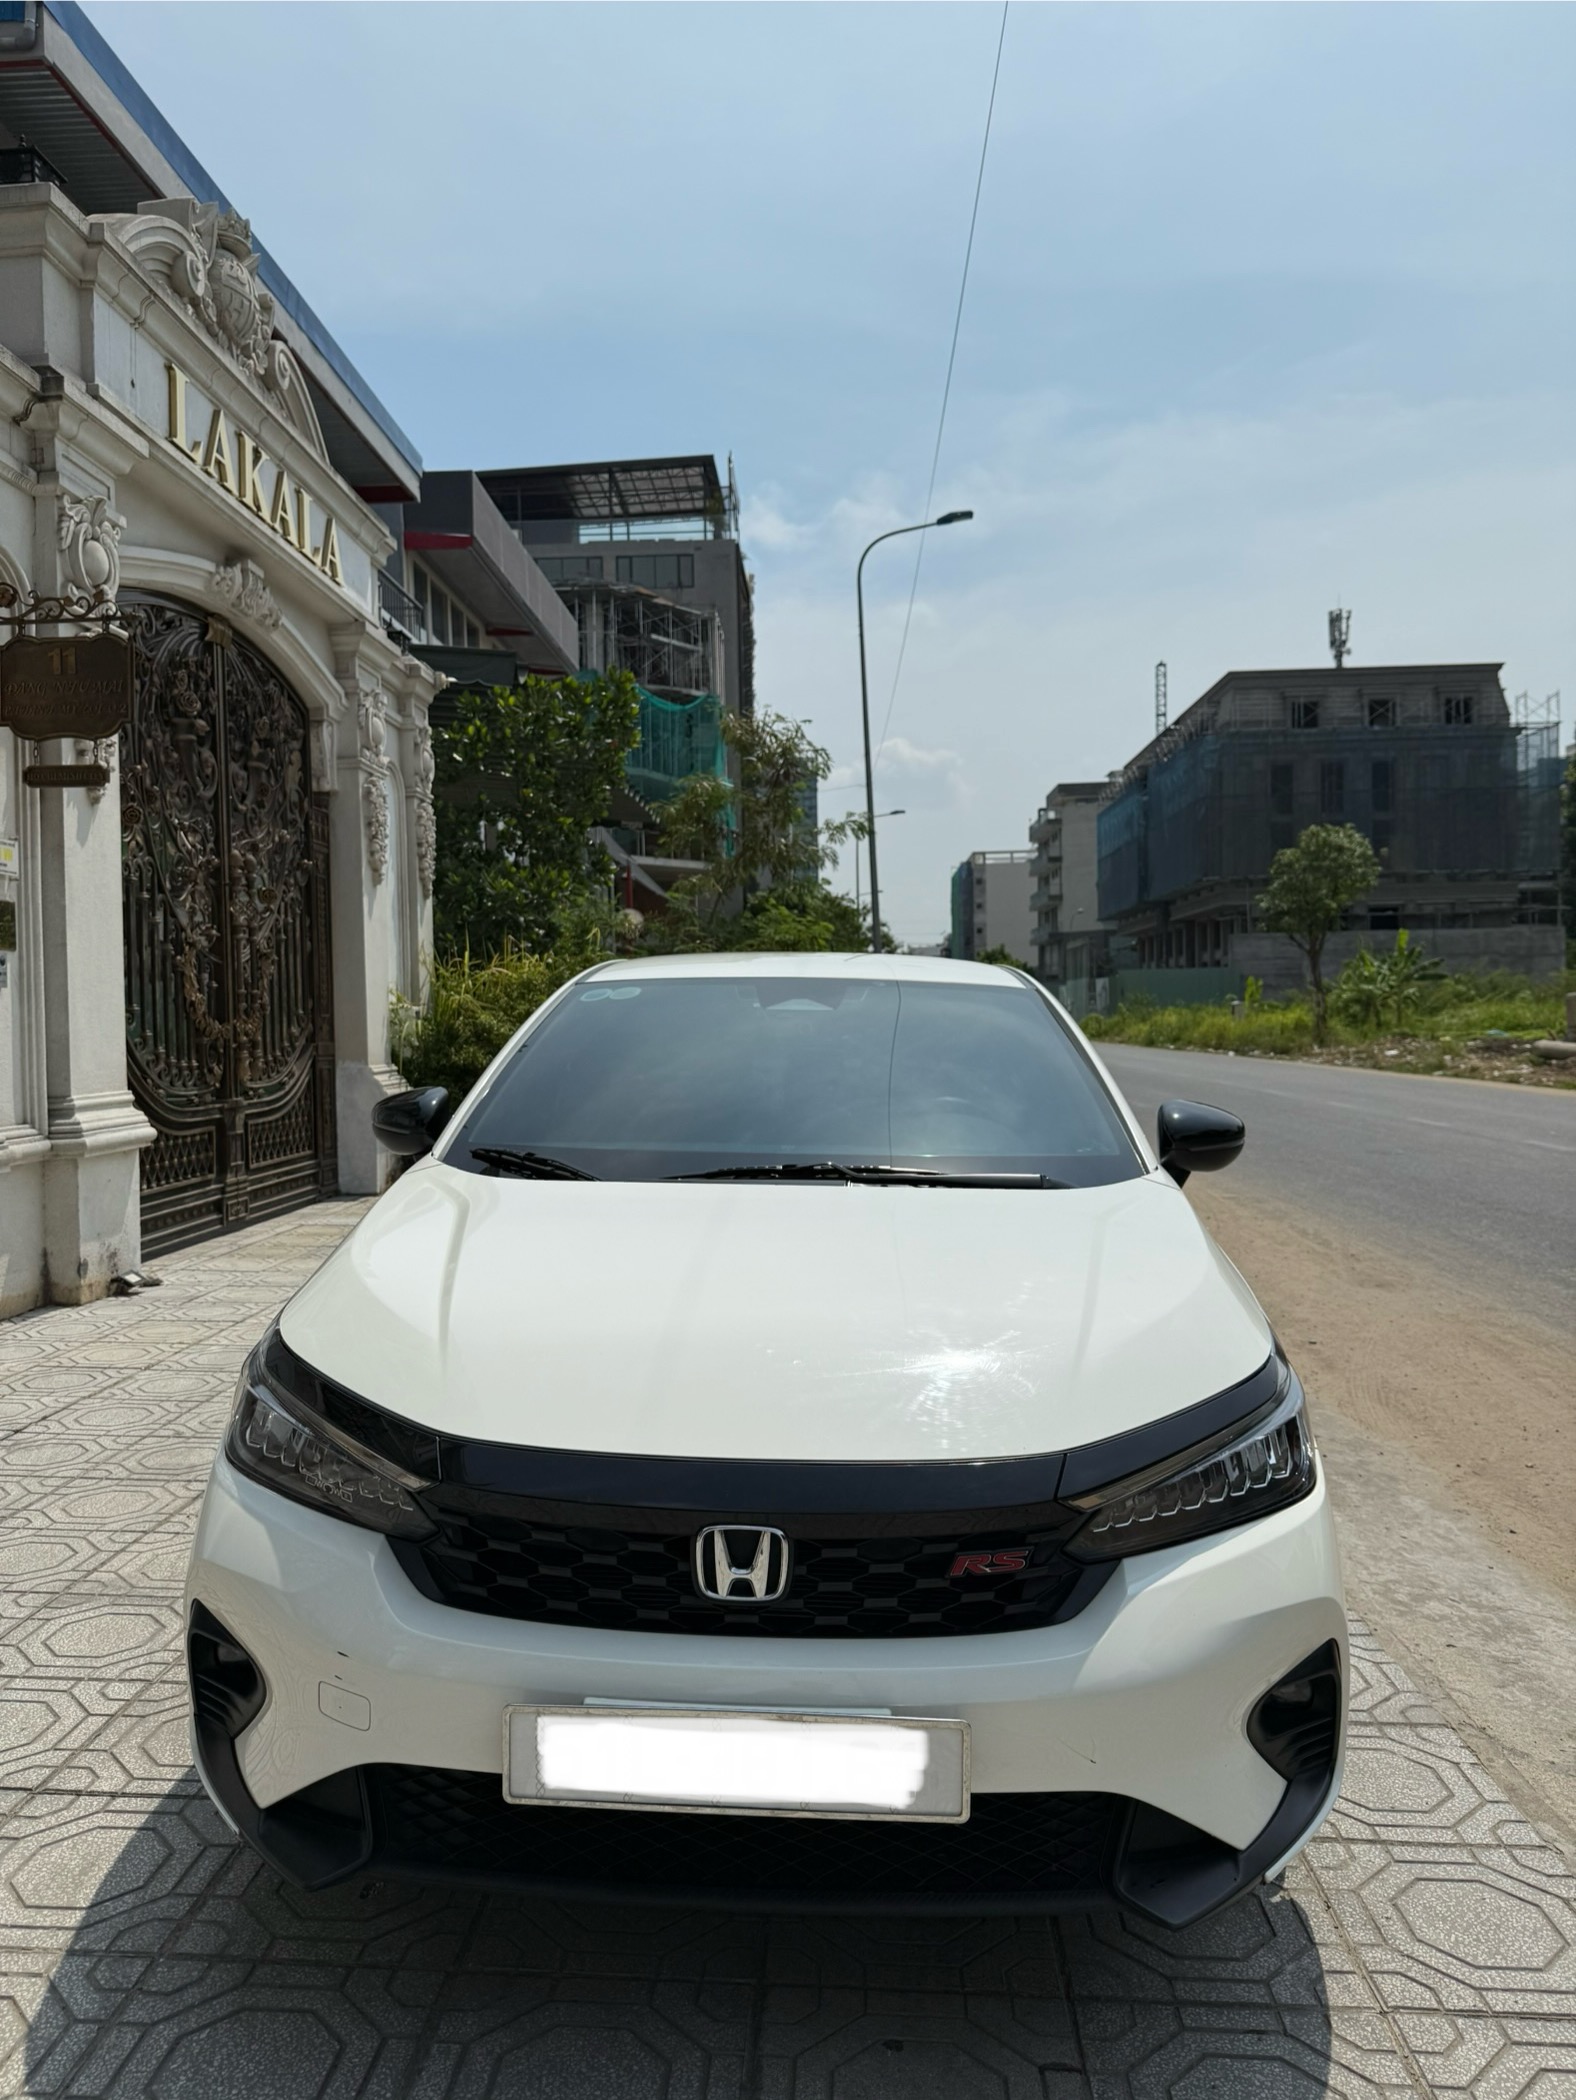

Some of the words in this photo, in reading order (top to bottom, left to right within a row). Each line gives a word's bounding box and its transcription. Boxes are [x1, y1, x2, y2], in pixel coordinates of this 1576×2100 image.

[167, 362, 345, 587] LAKALA
[47, 647, 77, 675] 11
[949, 1550, 1029, 1577] RS
